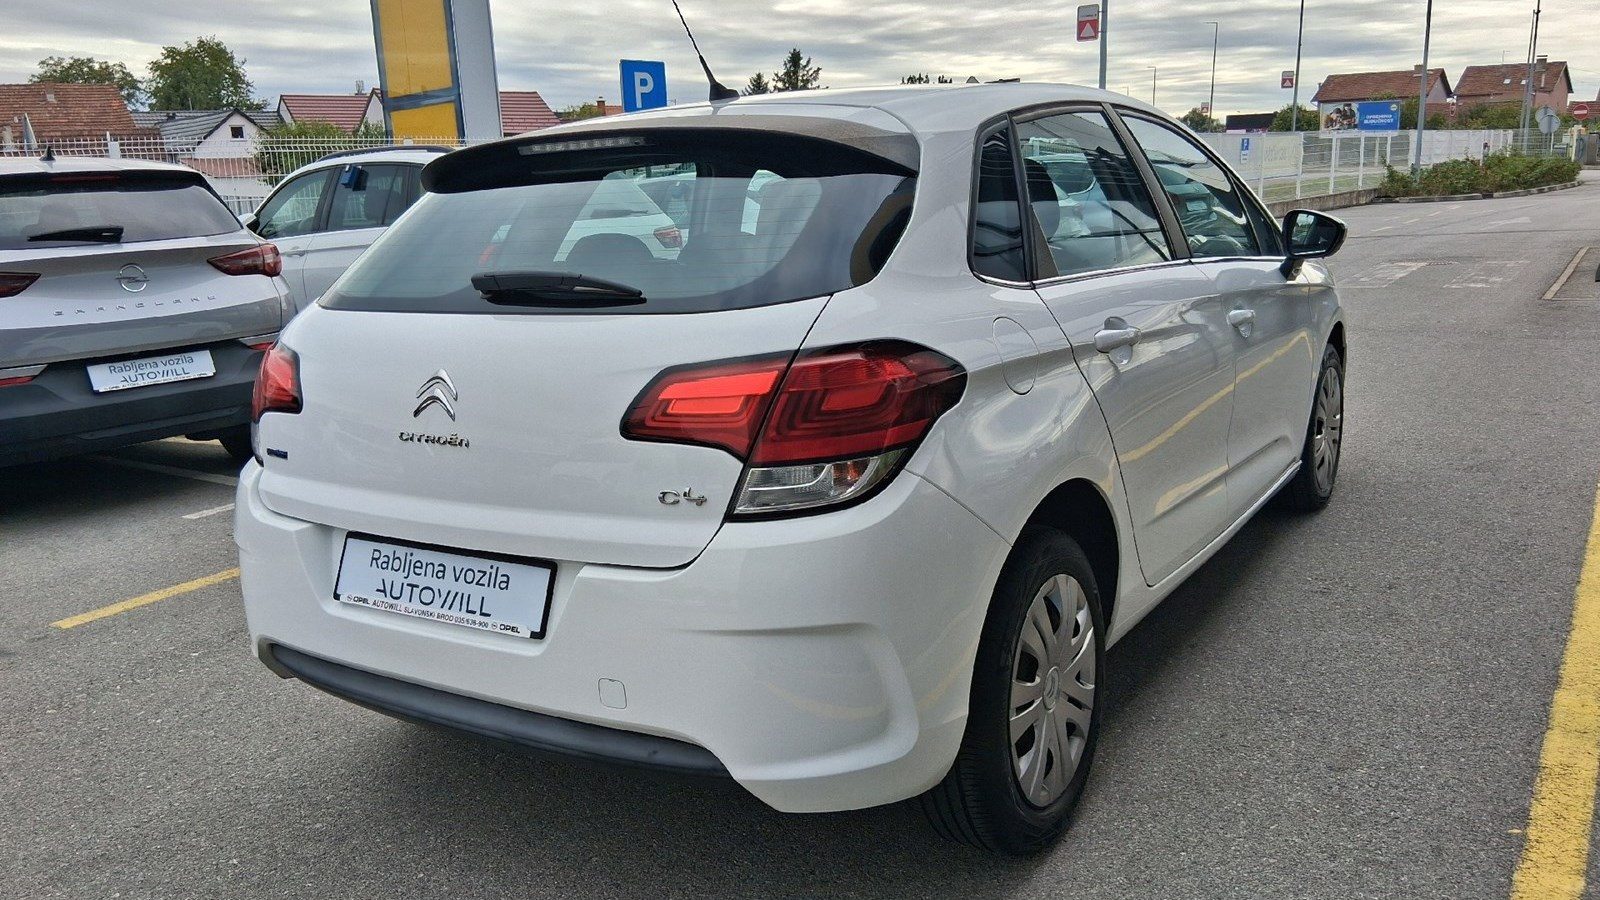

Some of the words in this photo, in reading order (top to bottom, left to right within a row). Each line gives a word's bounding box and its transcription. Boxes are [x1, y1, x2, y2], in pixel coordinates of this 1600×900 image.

[634, 72, 654, 108] P
[108, 361, 159, 374] Rabljena
[160, 355, 194, 367] vozila
[120, 367, 190, 383] AUTOWILL
[658, 486, 707, 506] C4
[370, 548, 446, 580] Rabljena
[453, 565, 511, 590] vozila
[352, 596, 370, 605] OPEL
[372, 599, 403, 613] AUTOWILL
[404, 606, 435, 618] SLAVONSKI
[436, 612, 454, 622] BROD
[499, 623, 521, 634] OPEL
[376, 578, 492, 617] AUTOWILL
